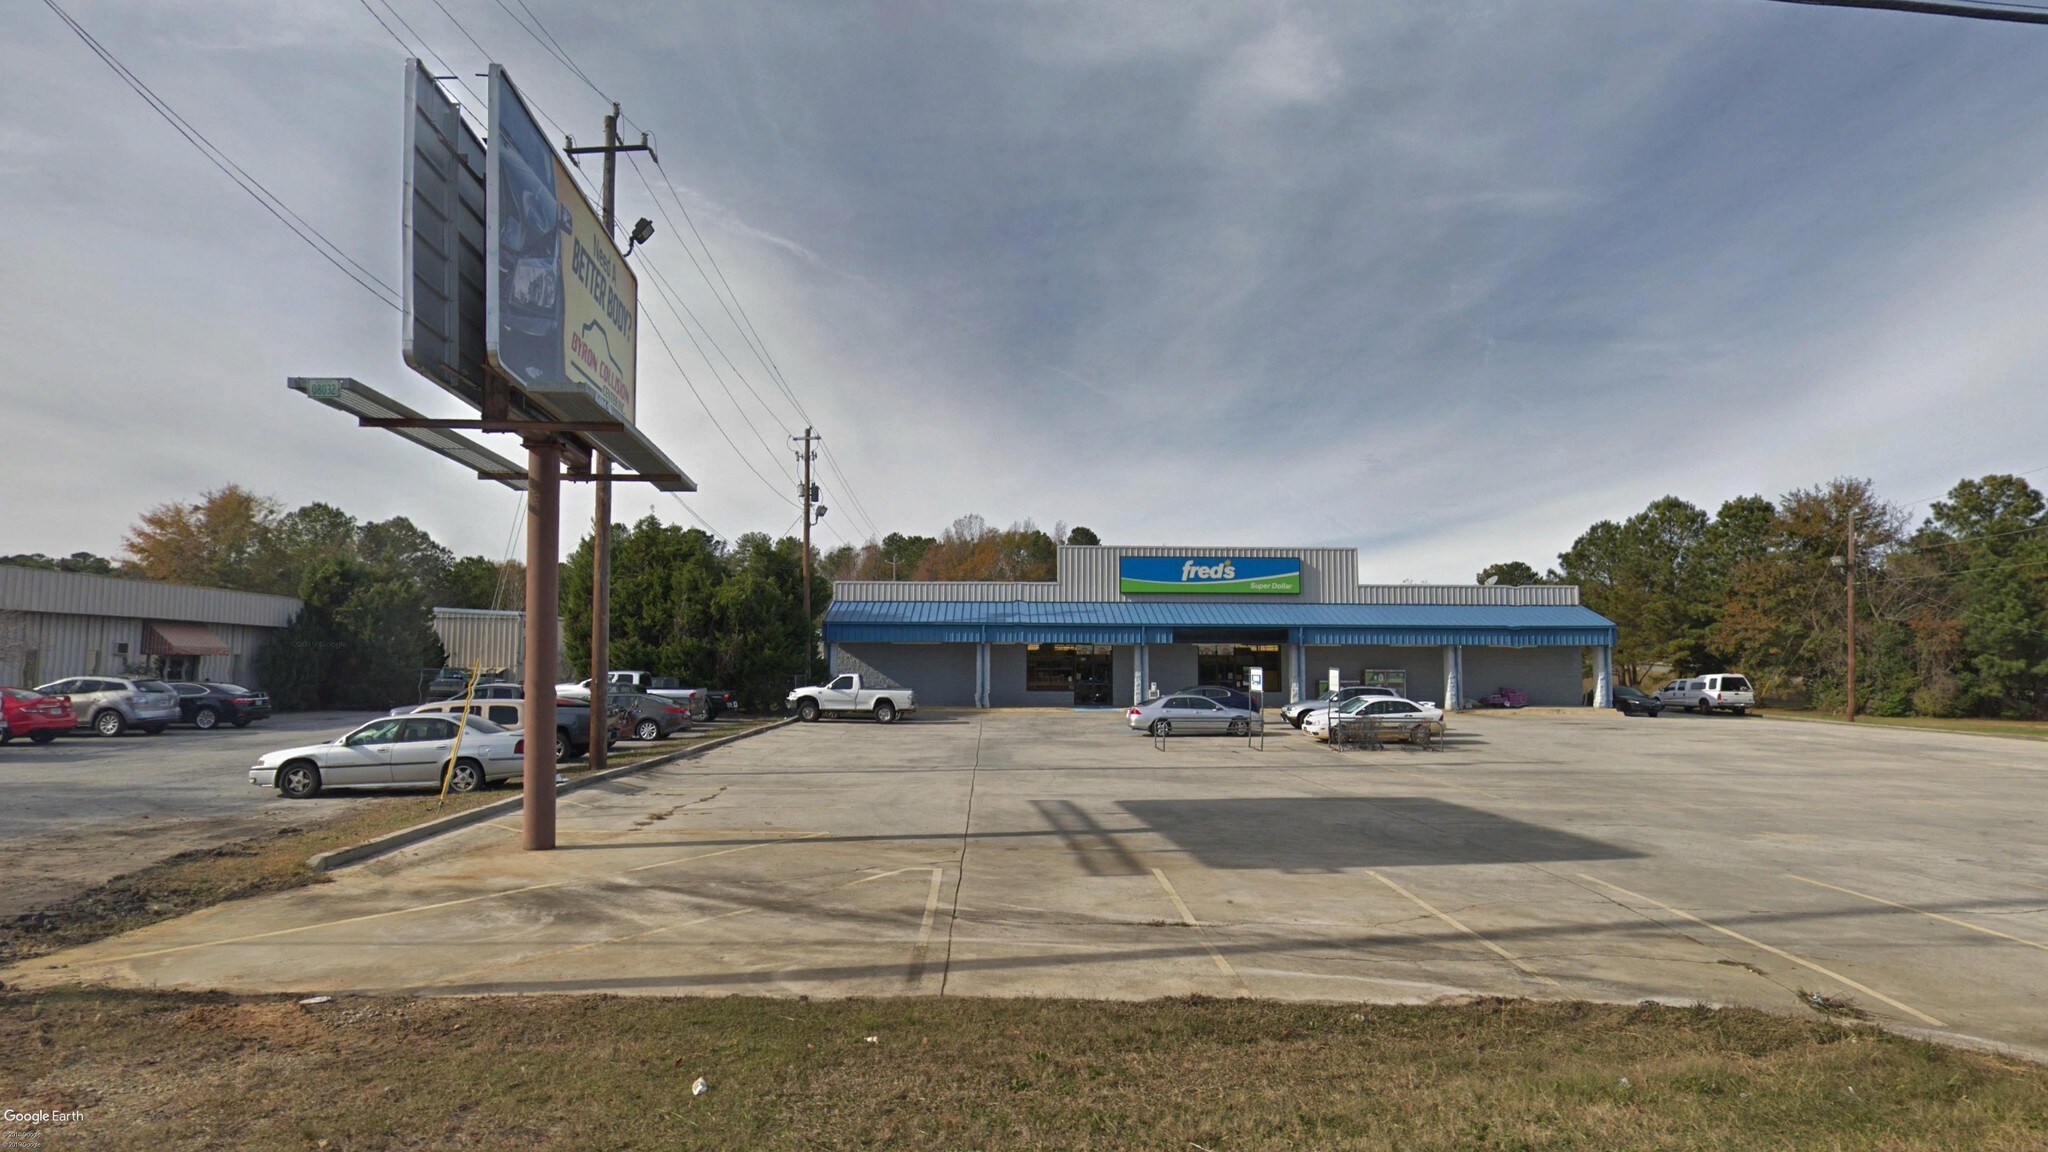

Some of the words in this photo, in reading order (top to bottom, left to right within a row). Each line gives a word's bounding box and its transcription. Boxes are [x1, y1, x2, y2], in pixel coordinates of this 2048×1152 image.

[593, 233, 611, 278] Need
[612, 263, 617, 287] A
[572, 236, 607, 311] BETTER
[606, 285, 632, 342] BODY?
[571, 331, 598, 373] BYRON
[600, 360, 629, 405] COLLISION
[602, 387, 619, 408] CENTER
[1181, 560, 1236, 581] fred's
[1250, 582, 1271, 590] Super
[1271, 582, 1292, 590] Dollar
